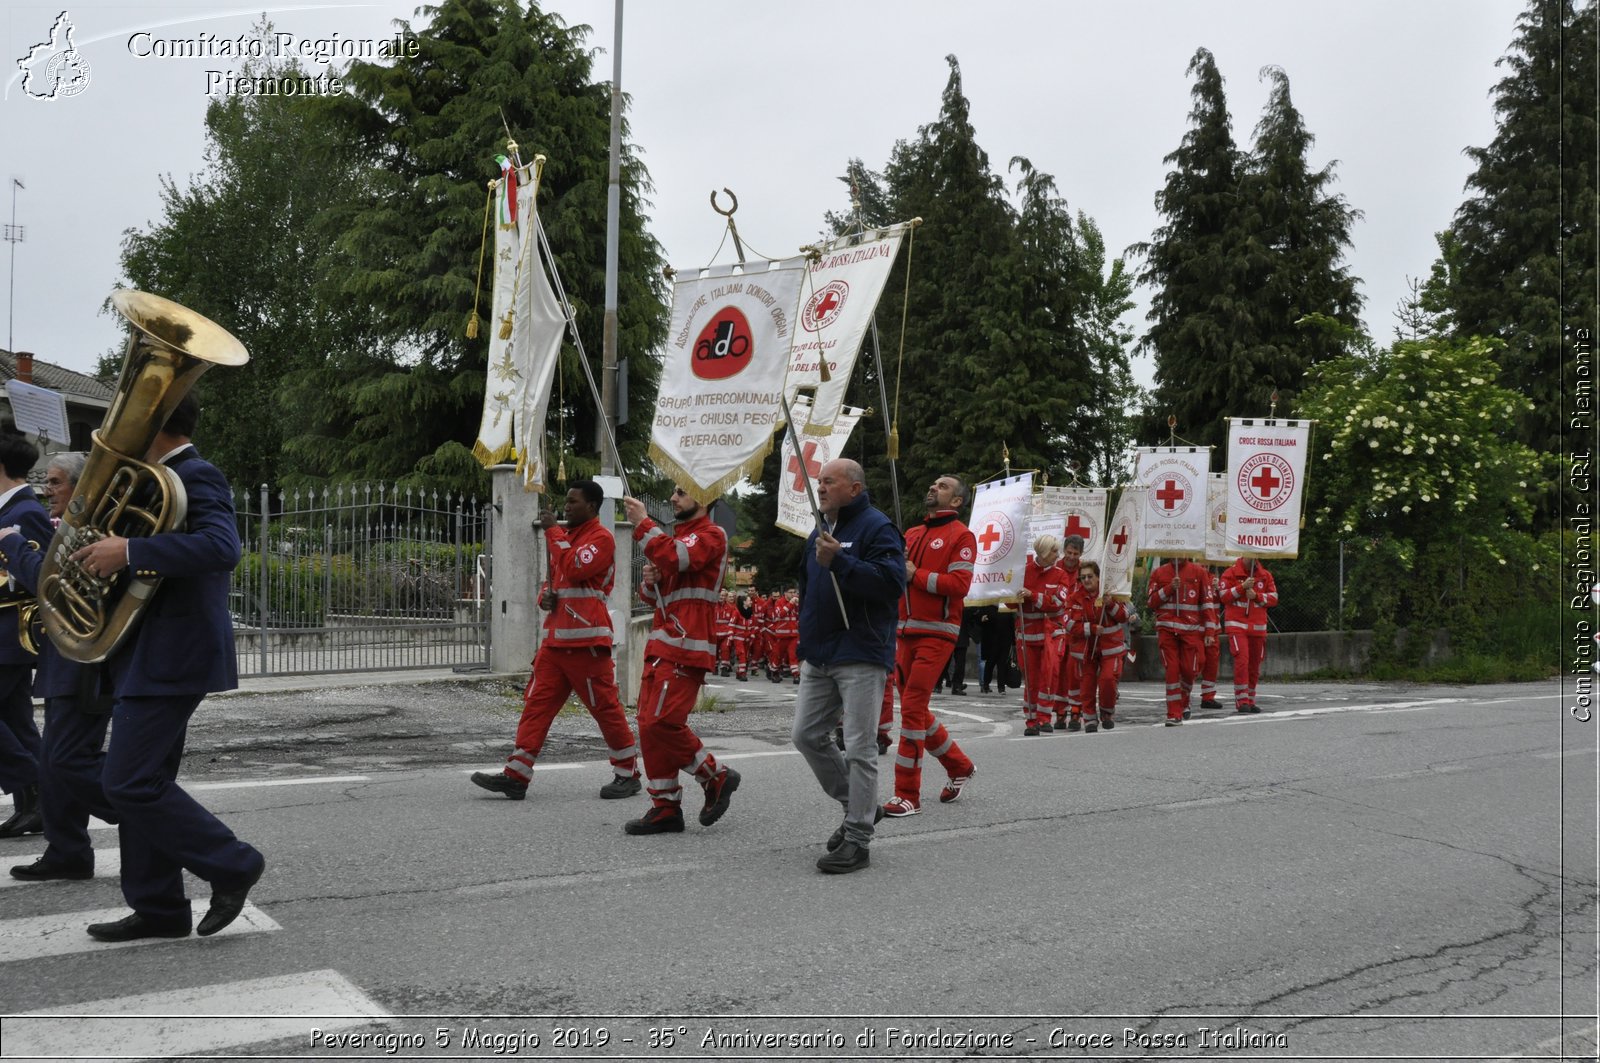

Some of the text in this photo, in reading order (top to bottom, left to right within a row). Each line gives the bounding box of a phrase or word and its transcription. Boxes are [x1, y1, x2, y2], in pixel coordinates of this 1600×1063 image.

[851, 244, 890, 263] ITALIANA
[675, 284, 788, 349] ASSOCIAZIONE ITALIANA DONATORI ORGANI
[696, 320, 749, 361] aido
[795, 363, 810, 371] DEL
[810, 361, 837, 371] BOO
[694, 391, 781, 406] INTERCOMUNALE
[700, 413, 739, 425] CHIUSA
[743, 411, 778, 425] PESIO
[680, 433, 743, 447] PEVERAGNO
[1239, 436, 1296, 446] CROCE ROSSA ITALIANA
[1143, 463, 1159, 478] CROCE
[1180, 460, 1199, 477] ITALIANA
[1240, 456, 1270, 487] CONVENZIONE
[1278, 462, 1292, 489] GINEVRA
[1252, 500, 1272, 510] AGOSTO
[1238, 517, 1267, 525] COMITATO
[1237, 534, 1287, 547] MONDOVI'
[972, 572, 1005, 583] ANTA
